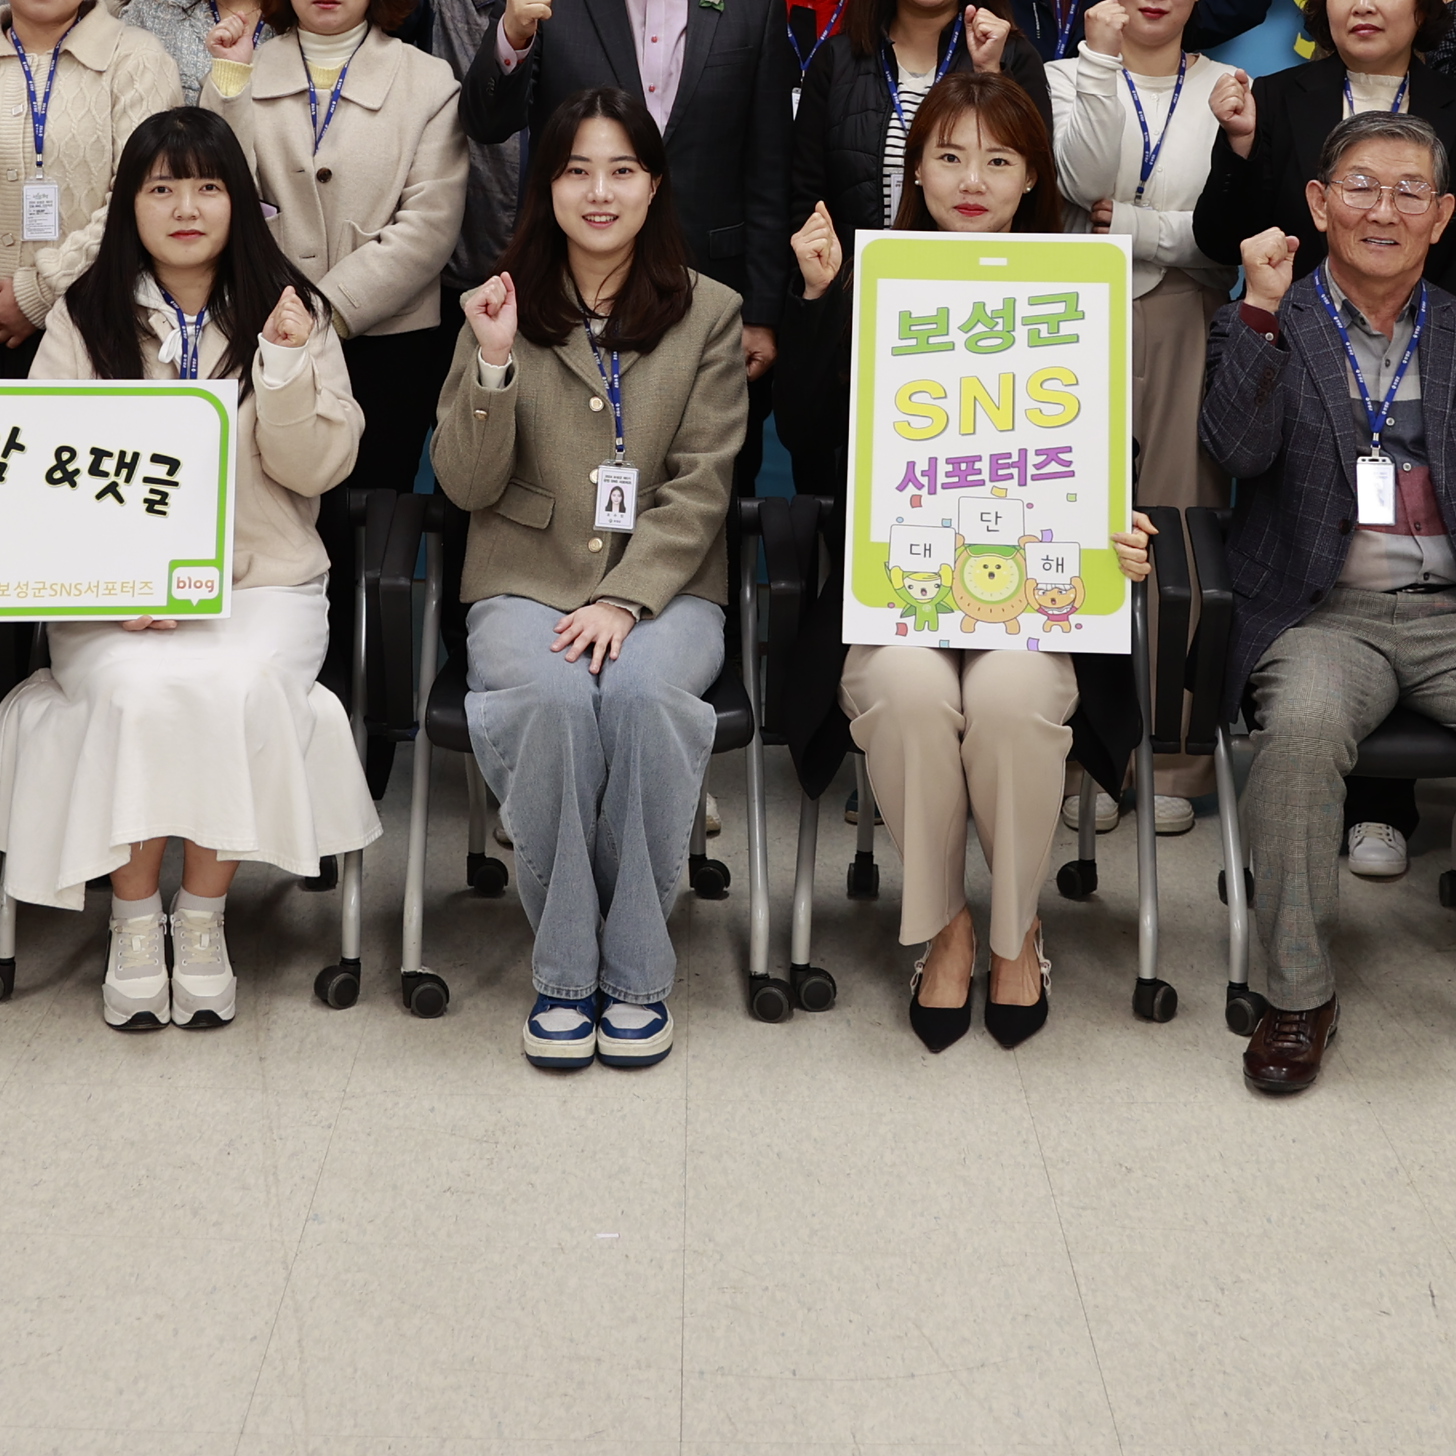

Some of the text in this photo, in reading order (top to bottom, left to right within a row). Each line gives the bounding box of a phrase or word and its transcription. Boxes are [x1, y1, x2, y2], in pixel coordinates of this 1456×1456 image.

[891, 291, 1085, 356] 보성군
[892, 366, 1081, 441] SNS
[895, 446, 1075, 495] 서포터즈
[980, 511, 1003, 533] 단
[909, 542, 932, 559] 대
[1041, 556, 1065, 575] 해
[176, 576, 215, 593] blog
